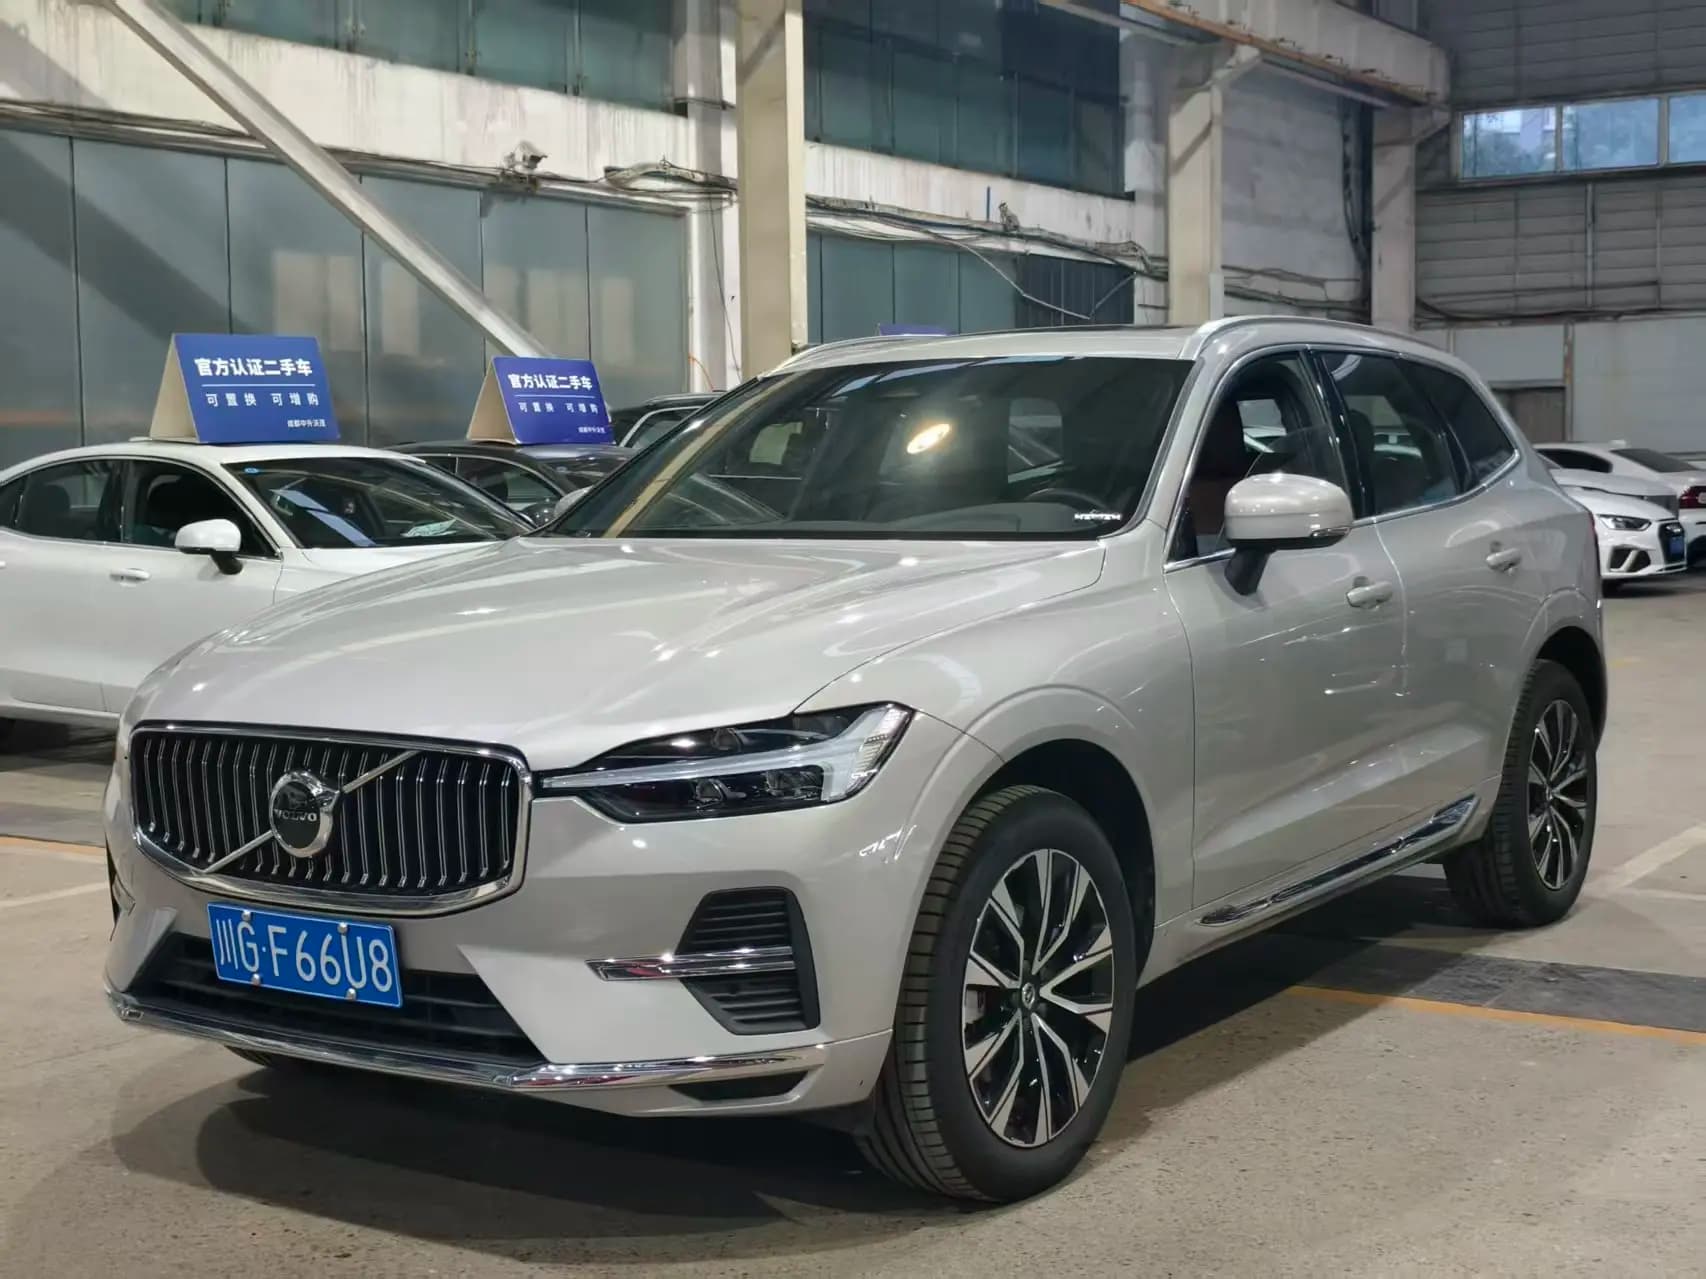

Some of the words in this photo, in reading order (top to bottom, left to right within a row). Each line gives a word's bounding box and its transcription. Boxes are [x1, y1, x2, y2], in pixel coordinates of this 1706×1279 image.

[194, 358, 312, 377] 官方认证二手车
[508, 373, 592, 390] 官方认证二手车
[205, 393, 257, 407] 可置换
[270, 393, 319, 407] 可增购
[273, 808, 317, 822] VOLVO
